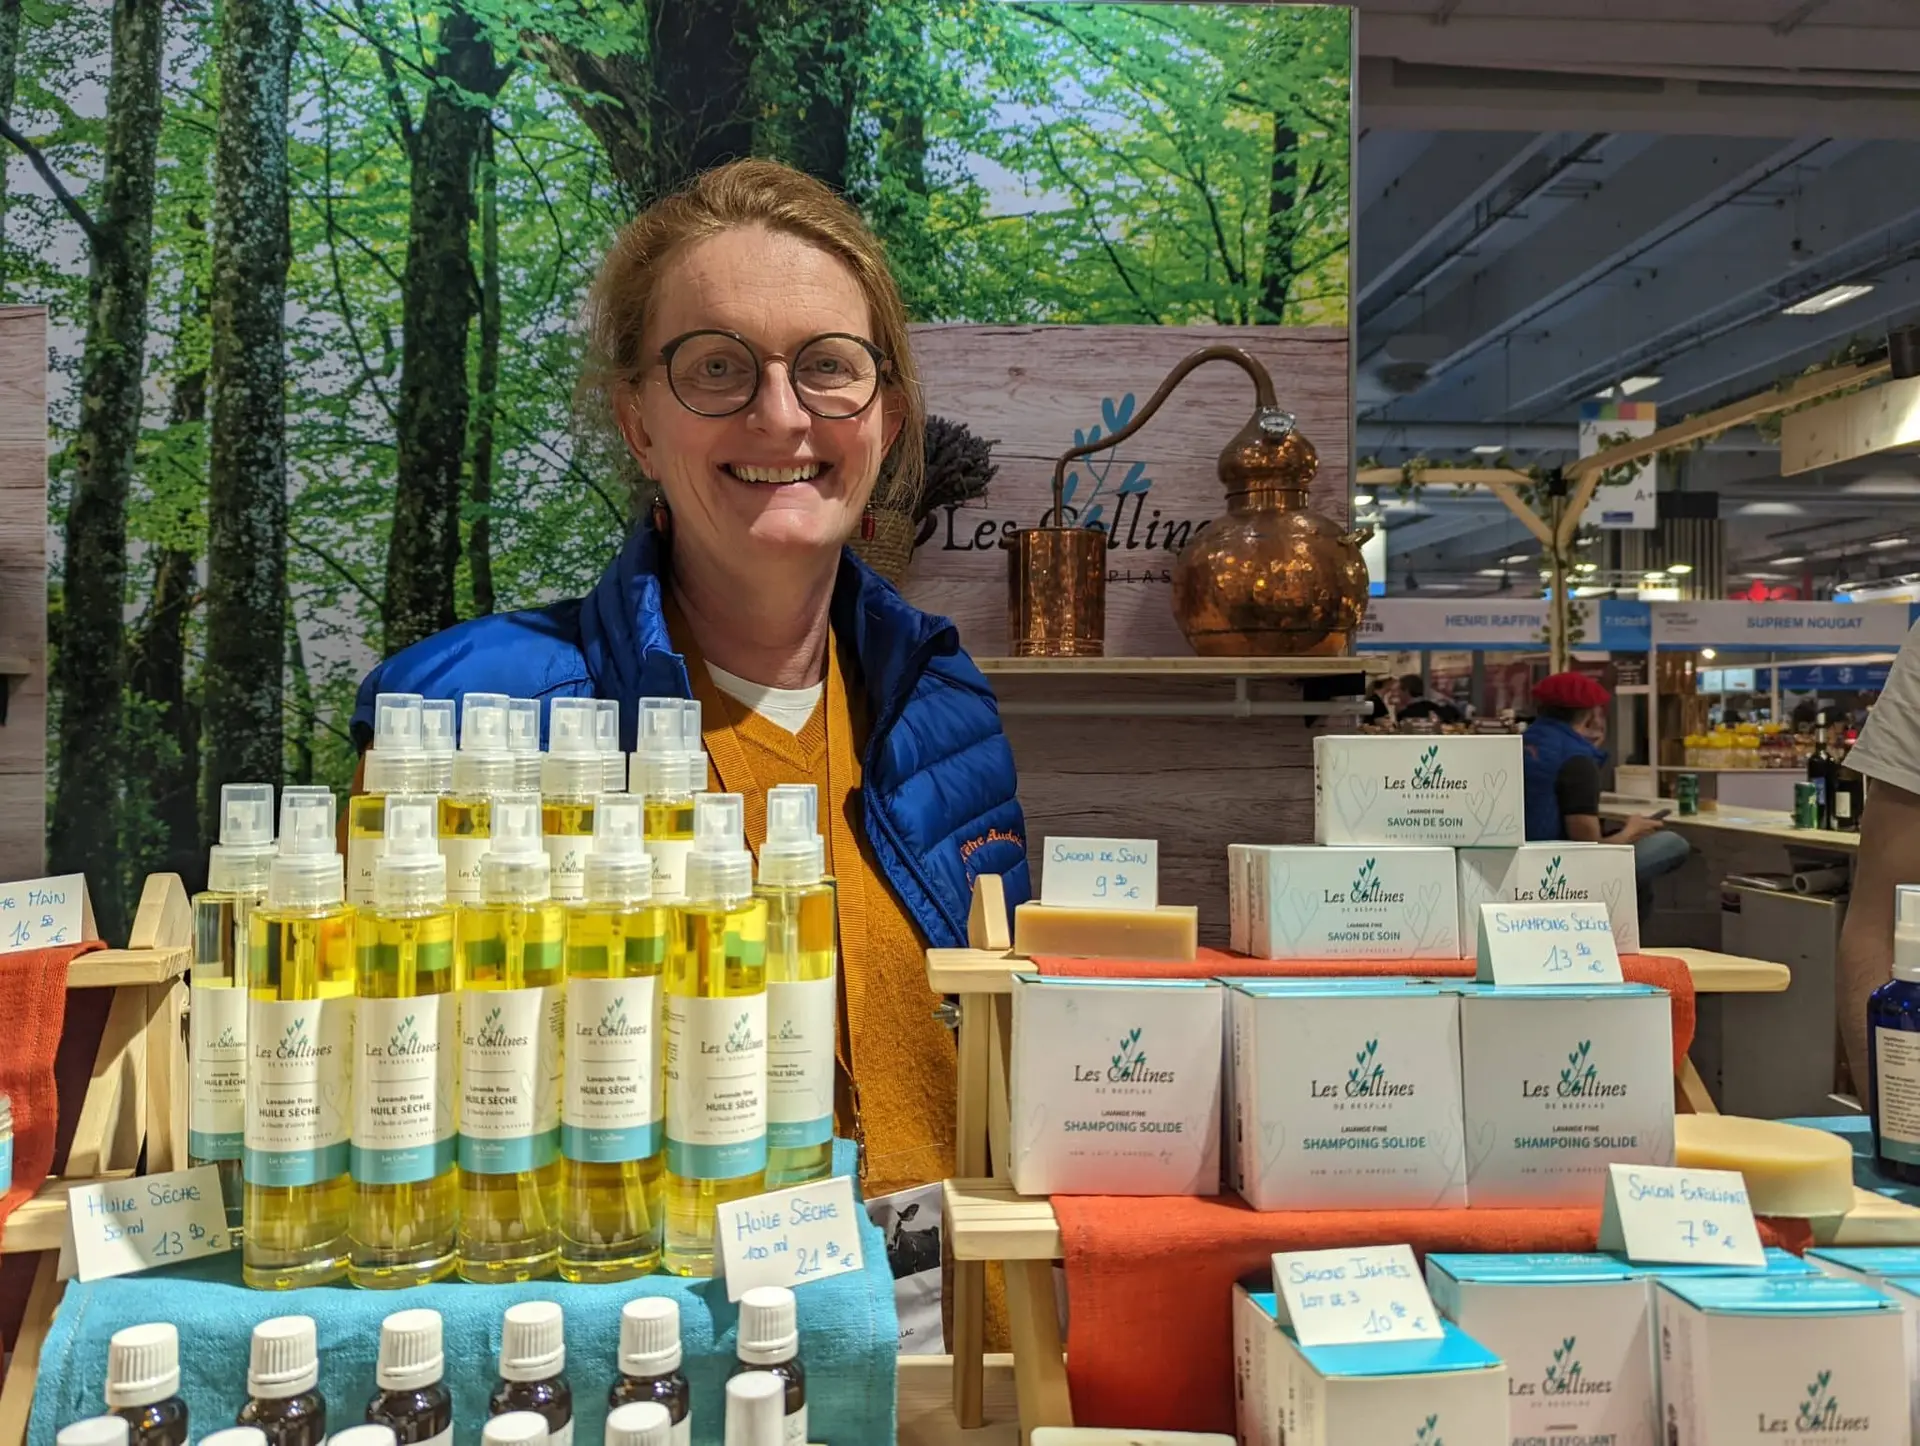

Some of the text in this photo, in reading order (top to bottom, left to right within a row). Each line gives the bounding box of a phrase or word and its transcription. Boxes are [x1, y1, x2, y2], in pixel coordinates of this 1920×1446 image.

[1108, 570, 1171, 583] PLAS
[1445, 615, 1541, 627] HENRI RAFFIN
[1747, 616, 1864, 629] SUPREM NOUGAT
[1384, 770, 1468, 790] Les Collines
[1387, 818, 1463, 827] SAVON DE SOIN
[1092, 876, 1107, 897] 9
[1324, 883, 1405, 903] Les Collines
[1515, 883, 1588, 900] Les Collines
[9, 920, 30, 947] 16
[1328, 932, 1400, 941] SAVON DE SOIN
[1543, 945, 1572, 971] 13
[463, 1027, 528, 1047] Les Collines
[576, 1018, 647, 1037] Les Collines
[256, 1042, 333, 1059] Les Collines
[365, 1041, 441, 1057] Les Collines
[700, 1032, 763, 1054] Les Collines
[1074, 1061, 1175, 1083] Les Collines
[580, 1083, 637, 1095] HUILE SÈCHE
[1311, 1073, 1415, 1098] Les Collines
[1523, 1073, 1627, 1098] Les Collines
[371, 1102, 432, 1116] HUILE SÈCHE
[465, 1094, 518, 1105] HUILE SÈCHE
[706, 1103, 732, 1112] HUILE
[259, 1105, 321, 1118] HUILE SÈCHE
[1064, 1121, 1183, 1133] SHAMPOING SOLIDE
[1303, 1136, 1426, 1149] SHAMPOING SOLIDE
[1514, 1136, 1637, 1149] SHAMPOING SOLIDE
[87, 1195, 138, 1217] HUILE
[735, 1210, 781, 1241] HUILE
[1676, 1219, 1699, 1248] 7
[104, 1219, 223, 1257] 50 ml 13 90 €
[742, 1246, 769, 1260] 100
[774, 1234, 788, 1252] ml
[795, 1247, 822, 1275] 21
[1363, 1309, 1392, 1335] 10
[1508, 1372, 1612, 1396] Les Collines
[1758, 1408, 1869, 1433] Les Collines
[1511, 1436, 1547, 1446] AVON
